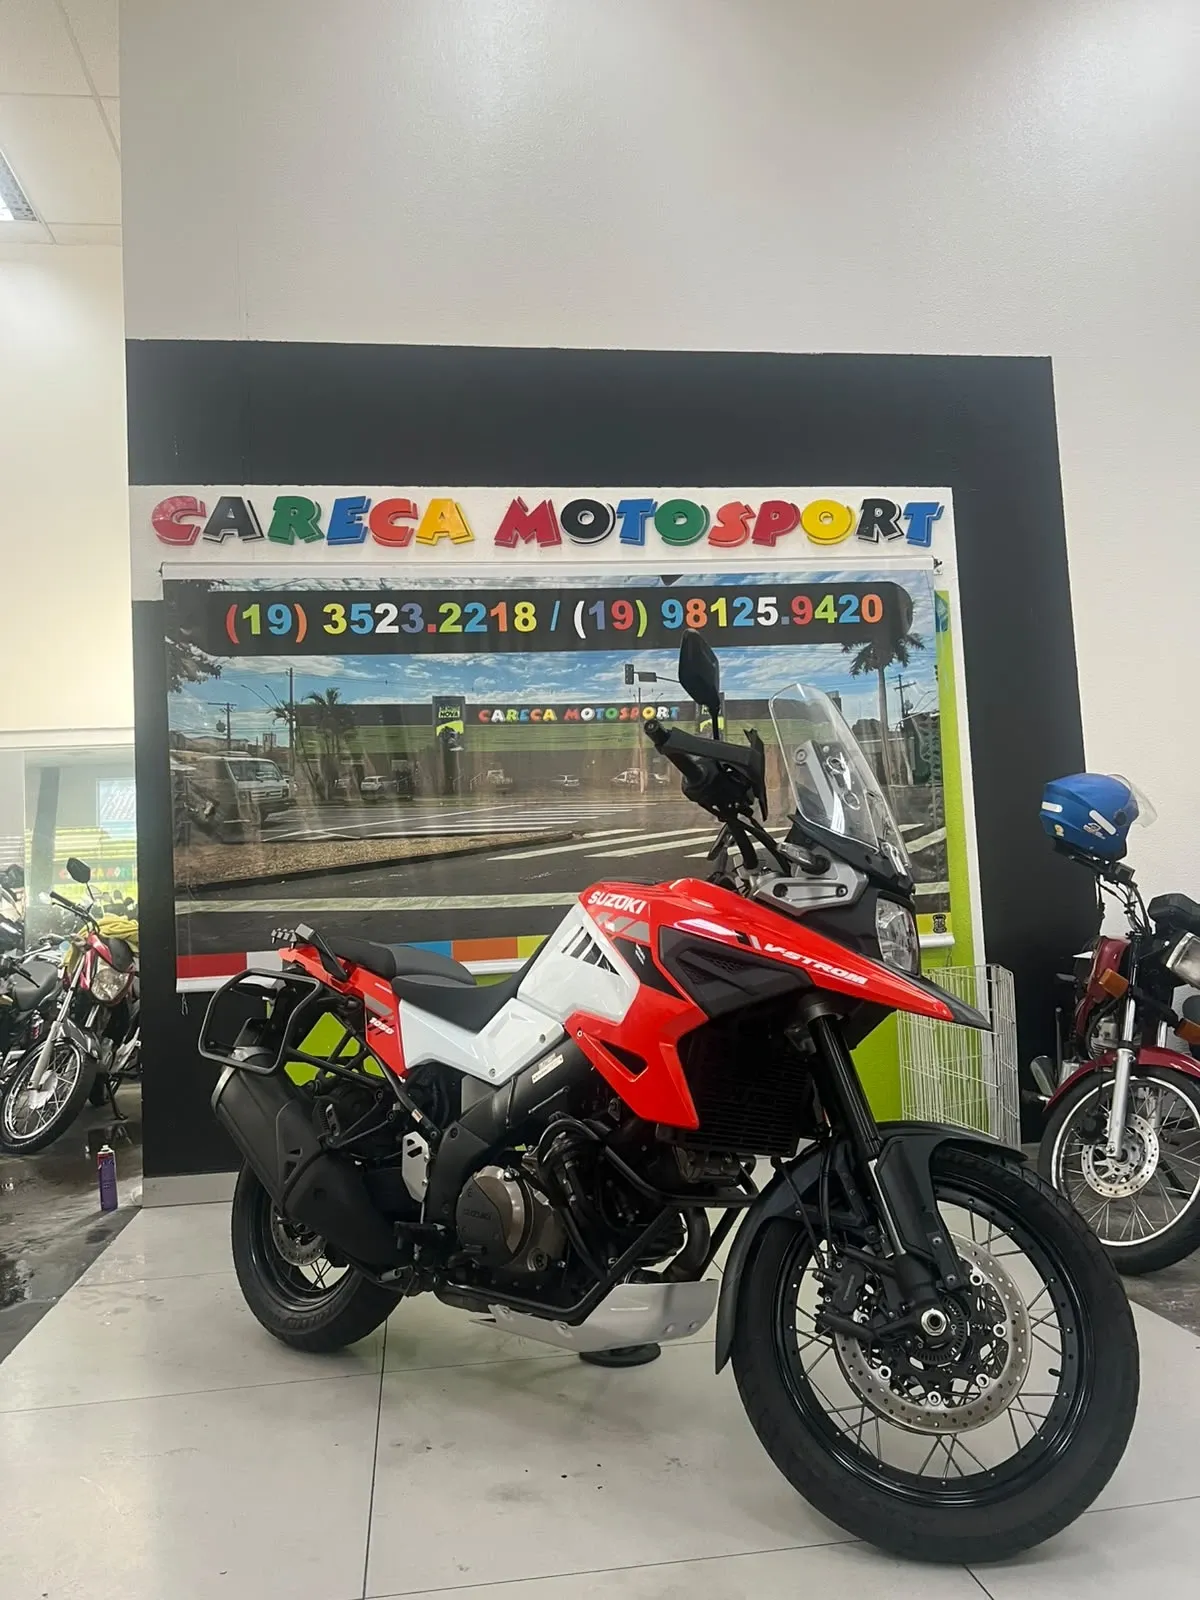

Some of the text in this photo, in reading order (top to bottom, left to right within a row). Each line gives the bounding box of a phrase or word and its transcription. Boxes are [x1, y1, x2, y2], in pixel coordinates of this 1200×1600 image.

[151, 495, 944, 548] CARECA MOTOSPORT
[225, 593, 883, 644] (19) 3523.2218 / (19) 98125.9420
[478, 705, 680, 723] CARECA MOTOSPORT
[587, 891, 647, 915] SUZUKI
[763, 942, 868, 985] V-STROM
[369, 1016, 395, 1035] 1050
